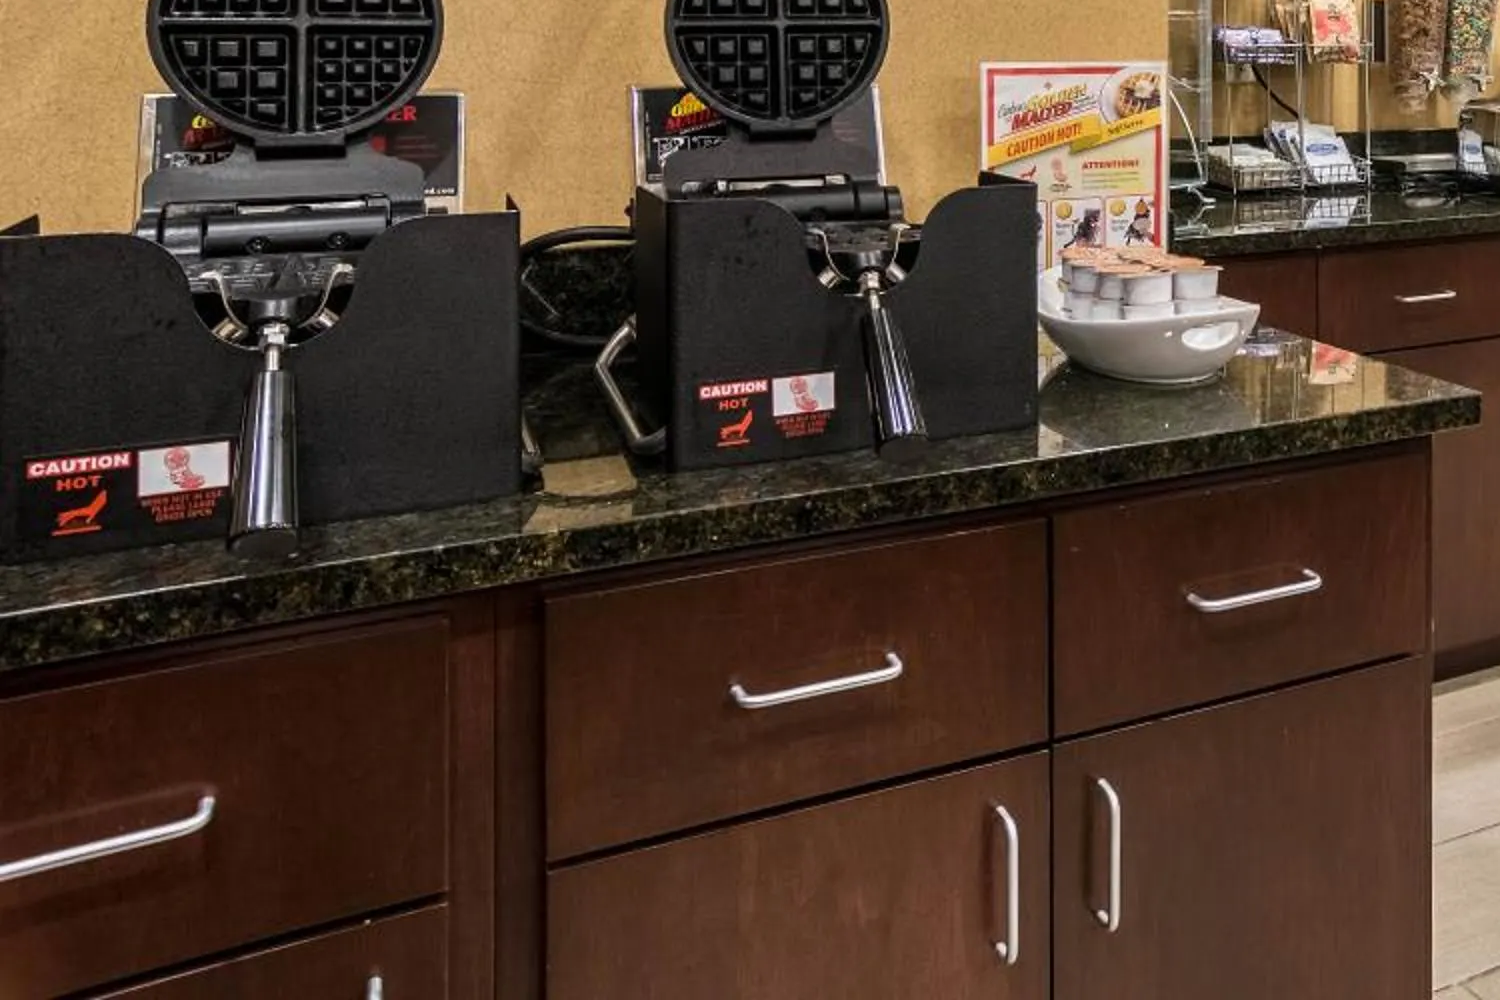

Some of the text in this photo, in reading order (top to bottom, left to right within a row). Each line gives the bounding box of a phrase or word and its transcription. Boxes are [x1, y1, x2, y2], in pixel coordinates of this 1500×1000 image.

[1007, 121, 1084, 158] CAUTION HOT!
[1082, 159, 1140, 169] ATTENTION!
[700, 380, 767, 399] CAUTION
[719, 397, 749, 411] HOT
[28, 451, 131, 477] CAUTION
[55, 475, 103, 492] HOT
